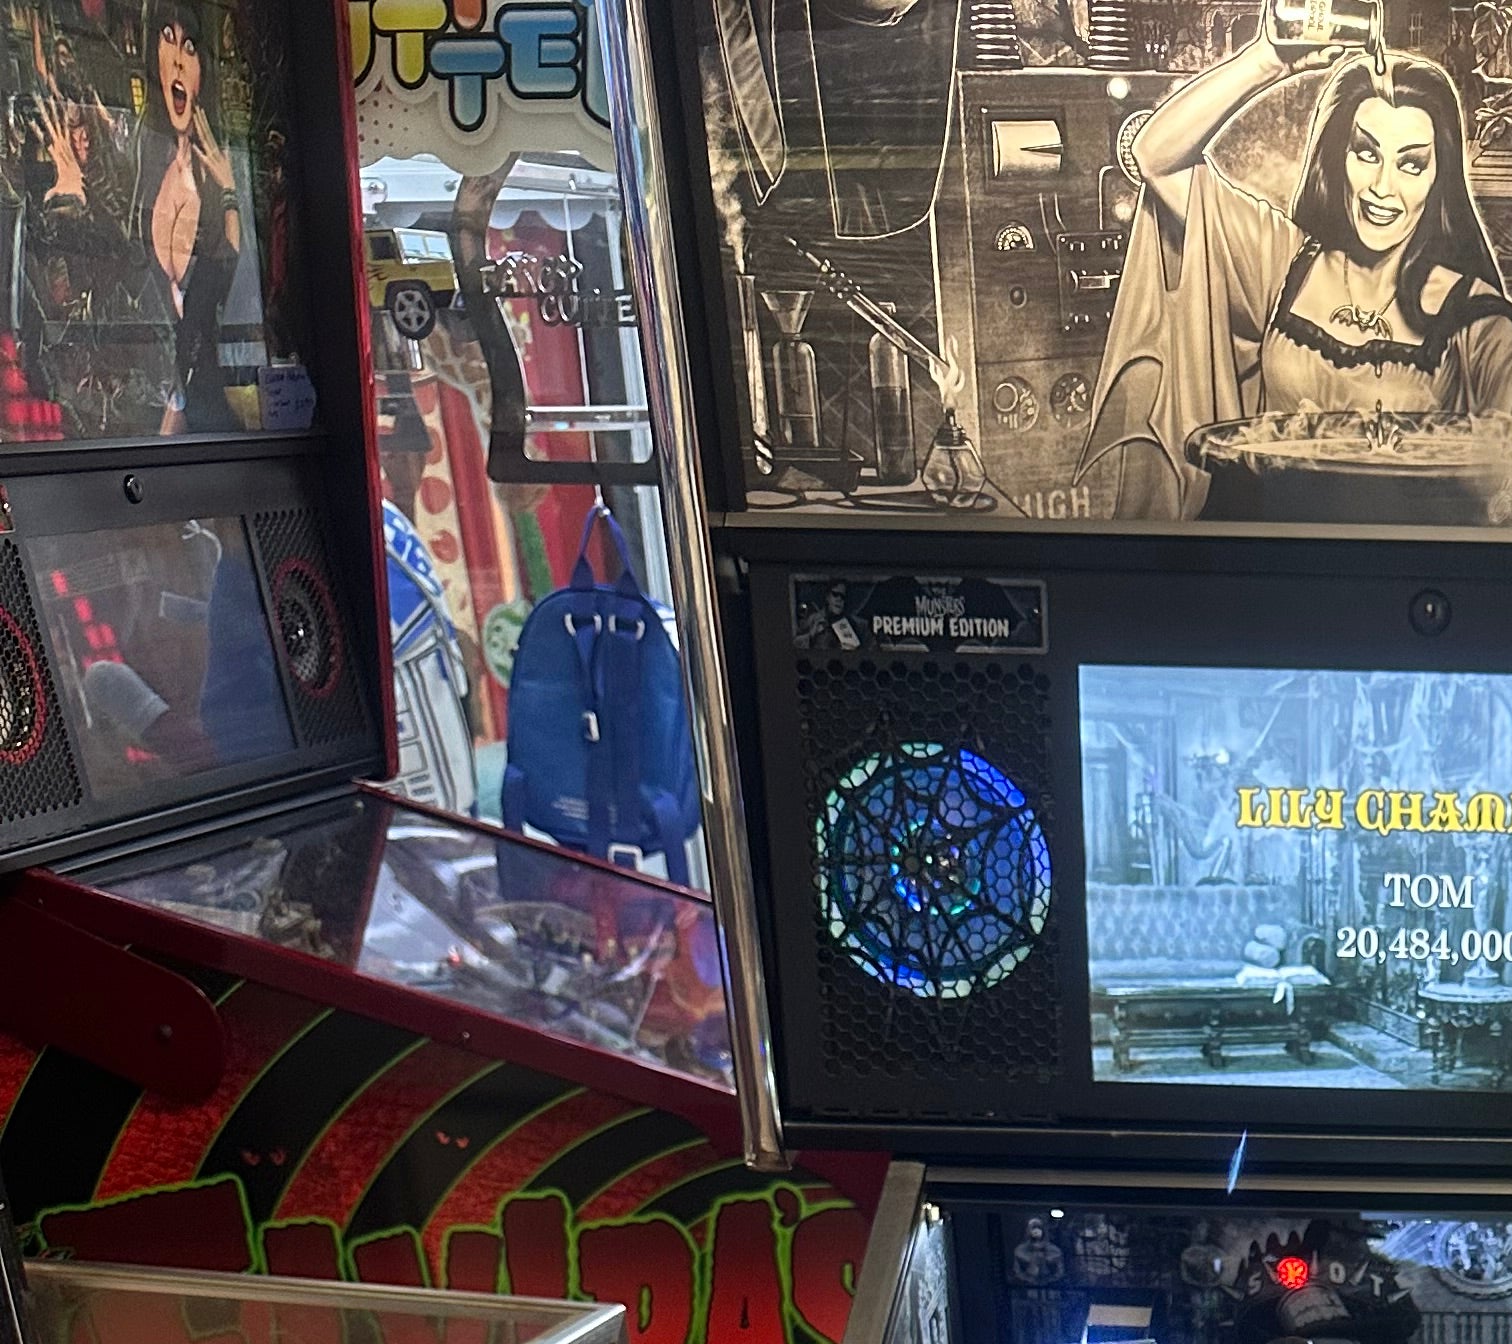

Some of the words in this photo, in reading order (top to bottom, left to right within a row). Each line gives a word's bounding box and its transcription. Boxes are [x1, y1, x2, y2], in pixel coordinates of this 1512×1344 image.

[872, 616, 943, 637] PREMIUM
[950, 618, 1009, 637] EDITION
[1236, 788, 1343, 829] LILY
[1384, 873, 1474, 910] TOM
